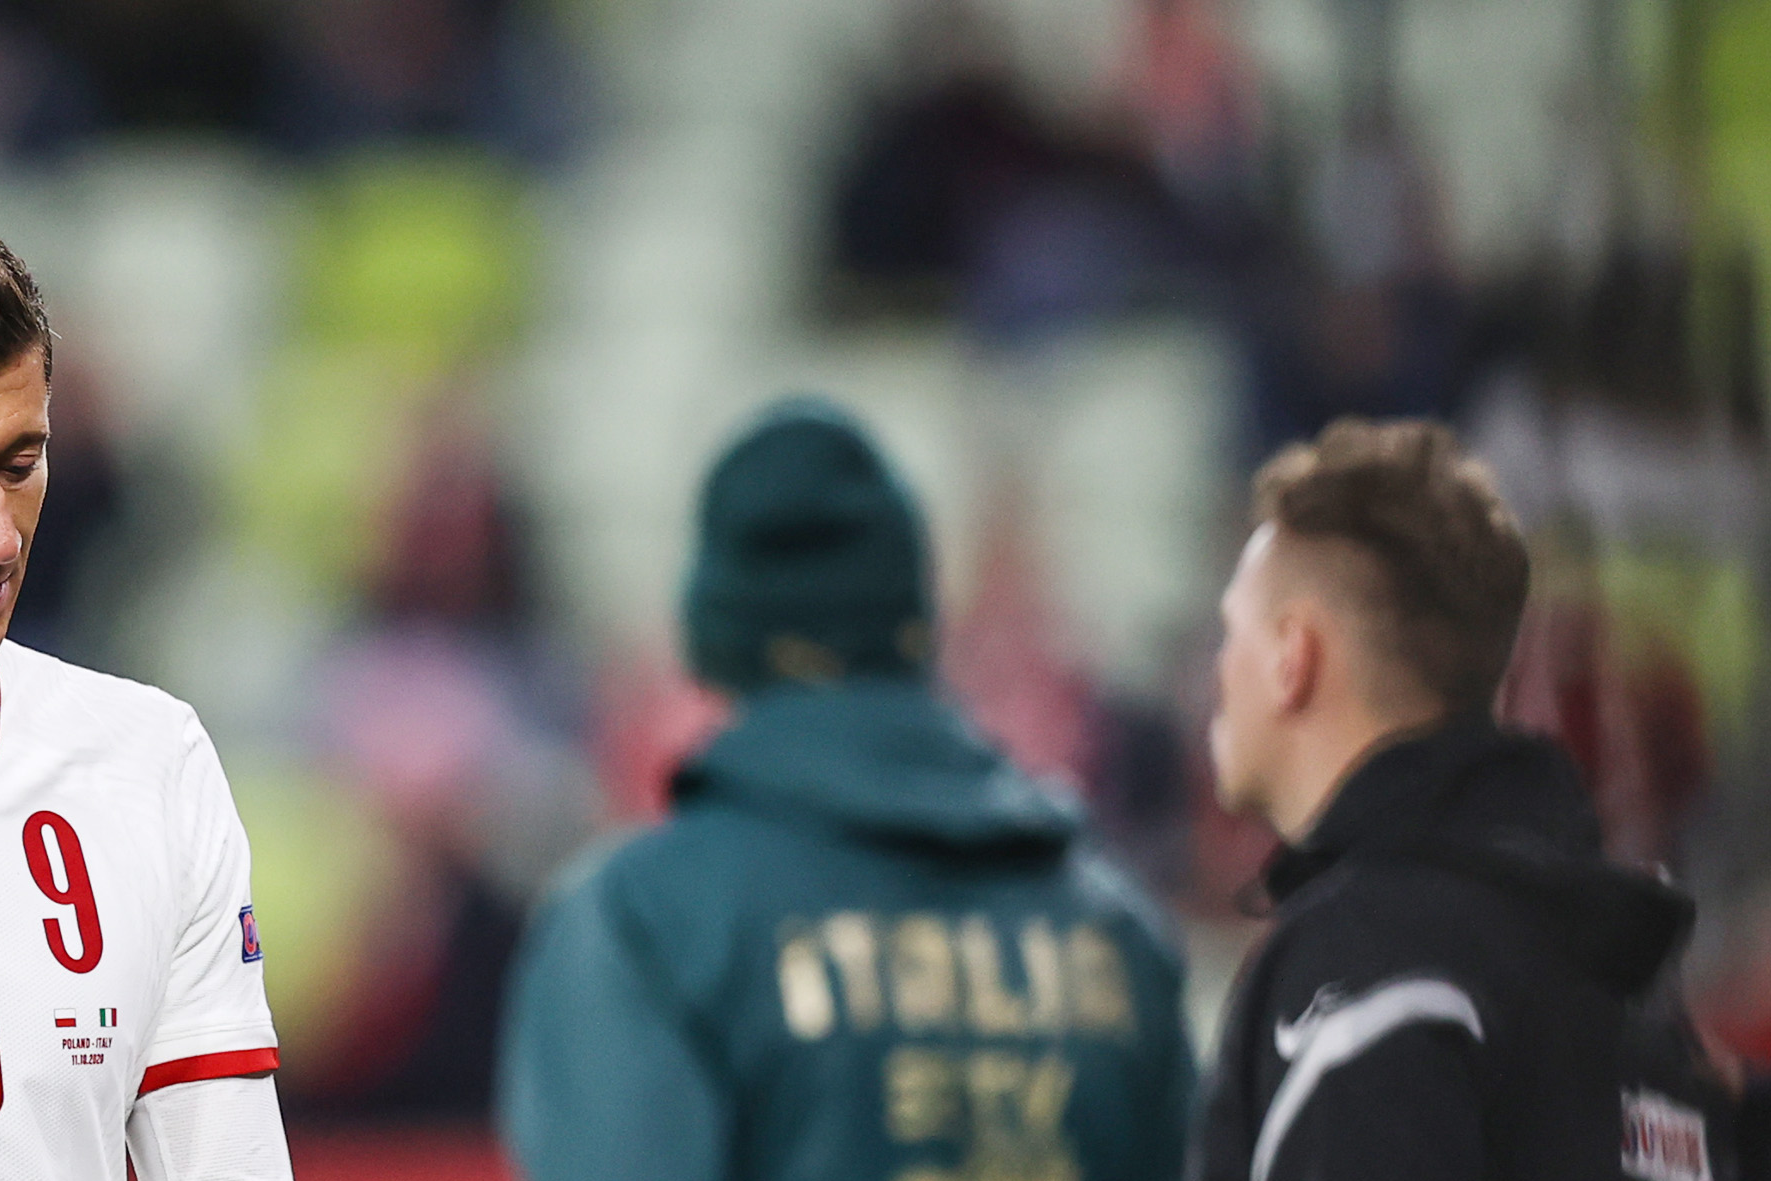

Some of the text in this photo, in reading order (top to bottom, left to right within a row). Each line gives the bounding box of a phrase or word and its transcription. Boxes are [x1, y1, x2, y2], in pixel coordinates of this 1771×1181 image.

[23, 810, 103, 973] 9
[62, 1038, 90, 1049] POLAND
[96, 1037, 113, 1048] ITALY
[71, 1053, 104, 1065] 11.10.2020
